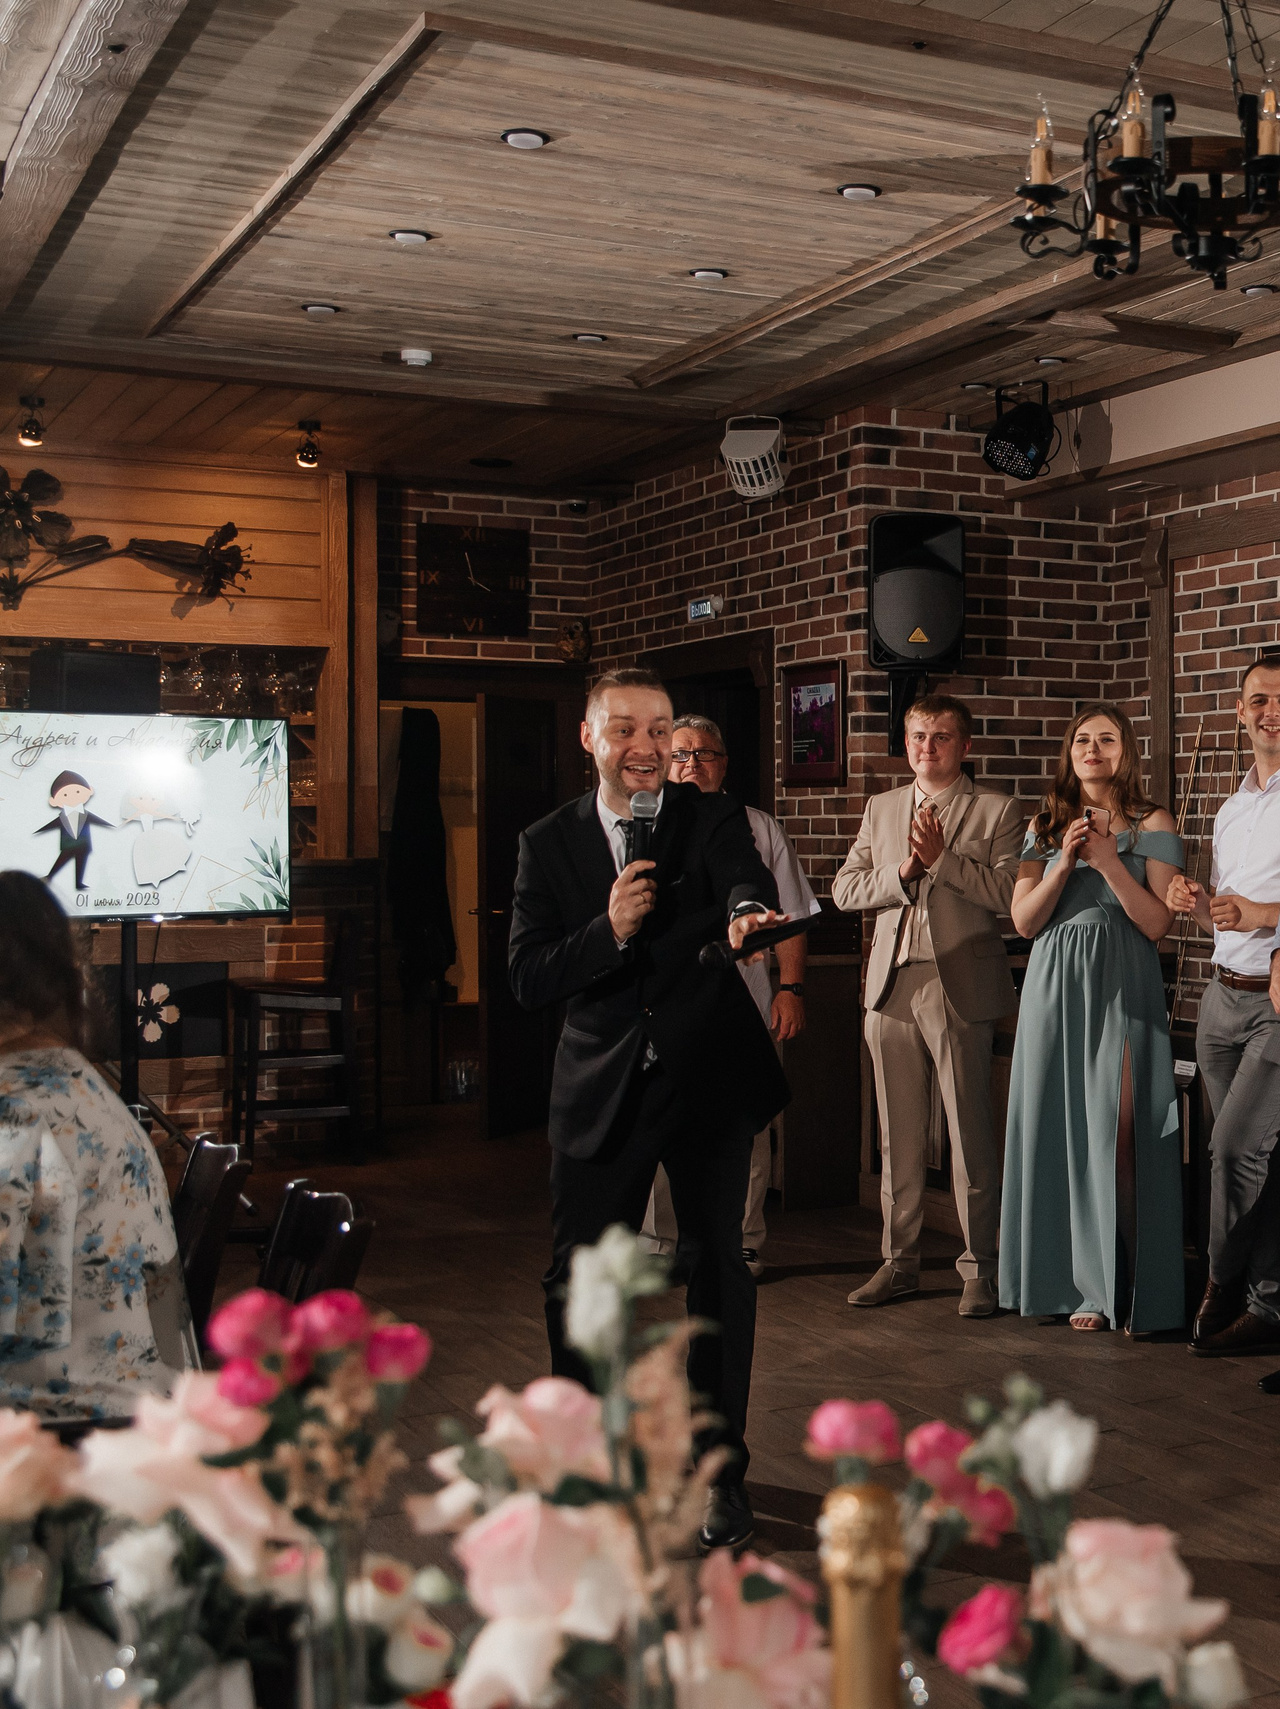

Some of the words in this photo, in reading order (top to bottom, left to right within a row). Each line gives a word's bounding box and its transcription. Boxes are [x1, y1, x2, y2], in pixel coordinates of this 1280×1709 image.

[419, 570, 440, 585] IX
[691, 601, 711, 617] ВЫХОД
[463, 617, 484, 632] VI
[0, 724, 79, 768] Андрей
[86, 734, 98, 746] и
[76, 893, 89, 907] 01
[127, 892, 160, 906] 2023
